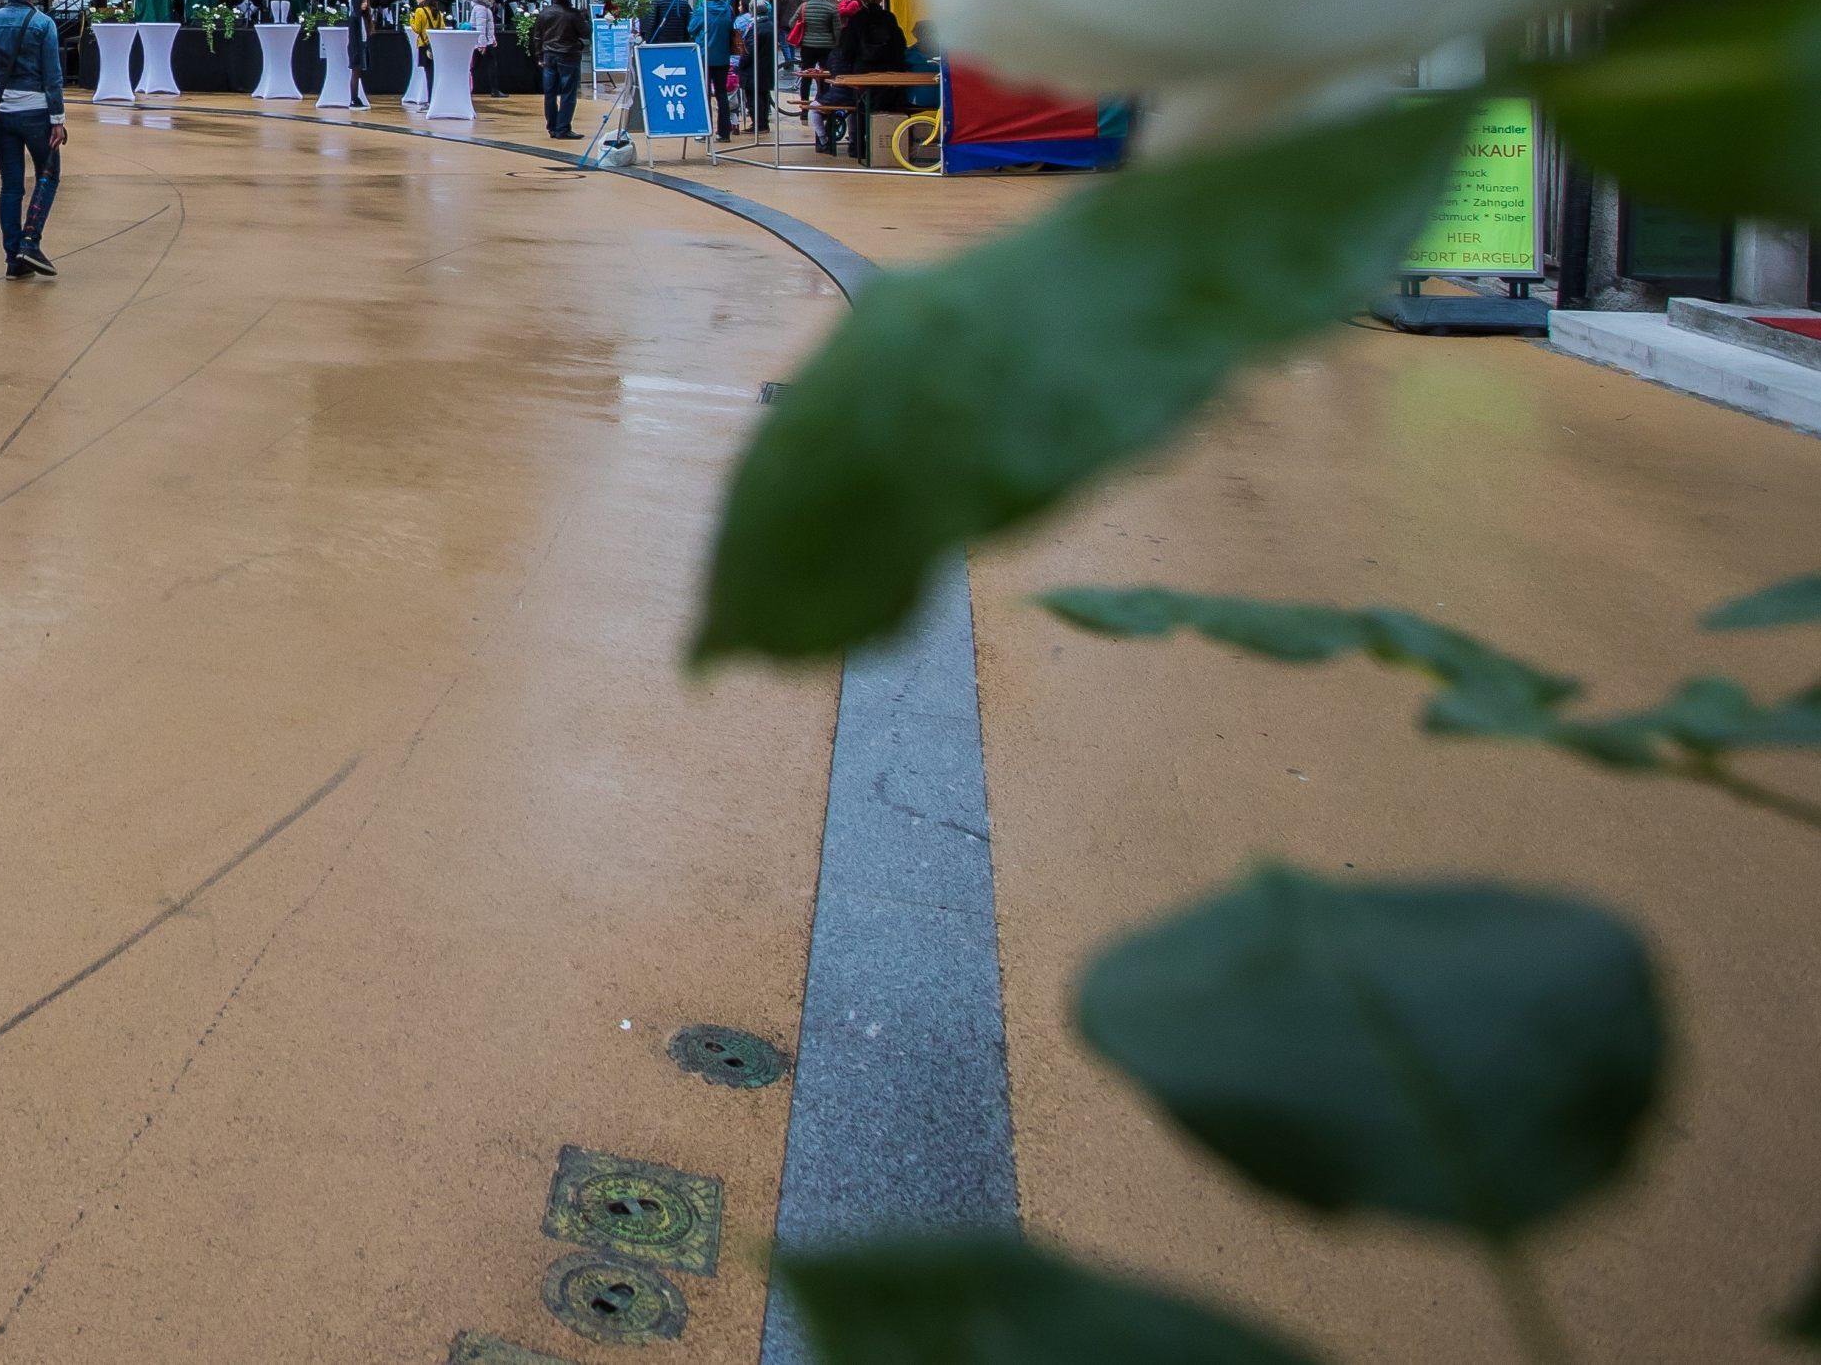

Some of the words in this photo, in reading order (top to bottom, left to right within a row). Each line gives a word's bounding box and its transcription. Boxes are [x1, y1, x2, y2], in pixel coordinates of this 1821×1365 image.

[658, 84, 688, 98] WC
[1482, 125, 1528, 134] Händler
[1462, 144, 1528, 158] NKAUF
[1476, 184, 1519, 192] Münzen
[1473, 198, 1525, 209] Zahngold
[1494, 214, 1527, 222] Silber
[1447, 233, 1482, 243] HIER
[1406, 251, 1457, 262] OFORT
